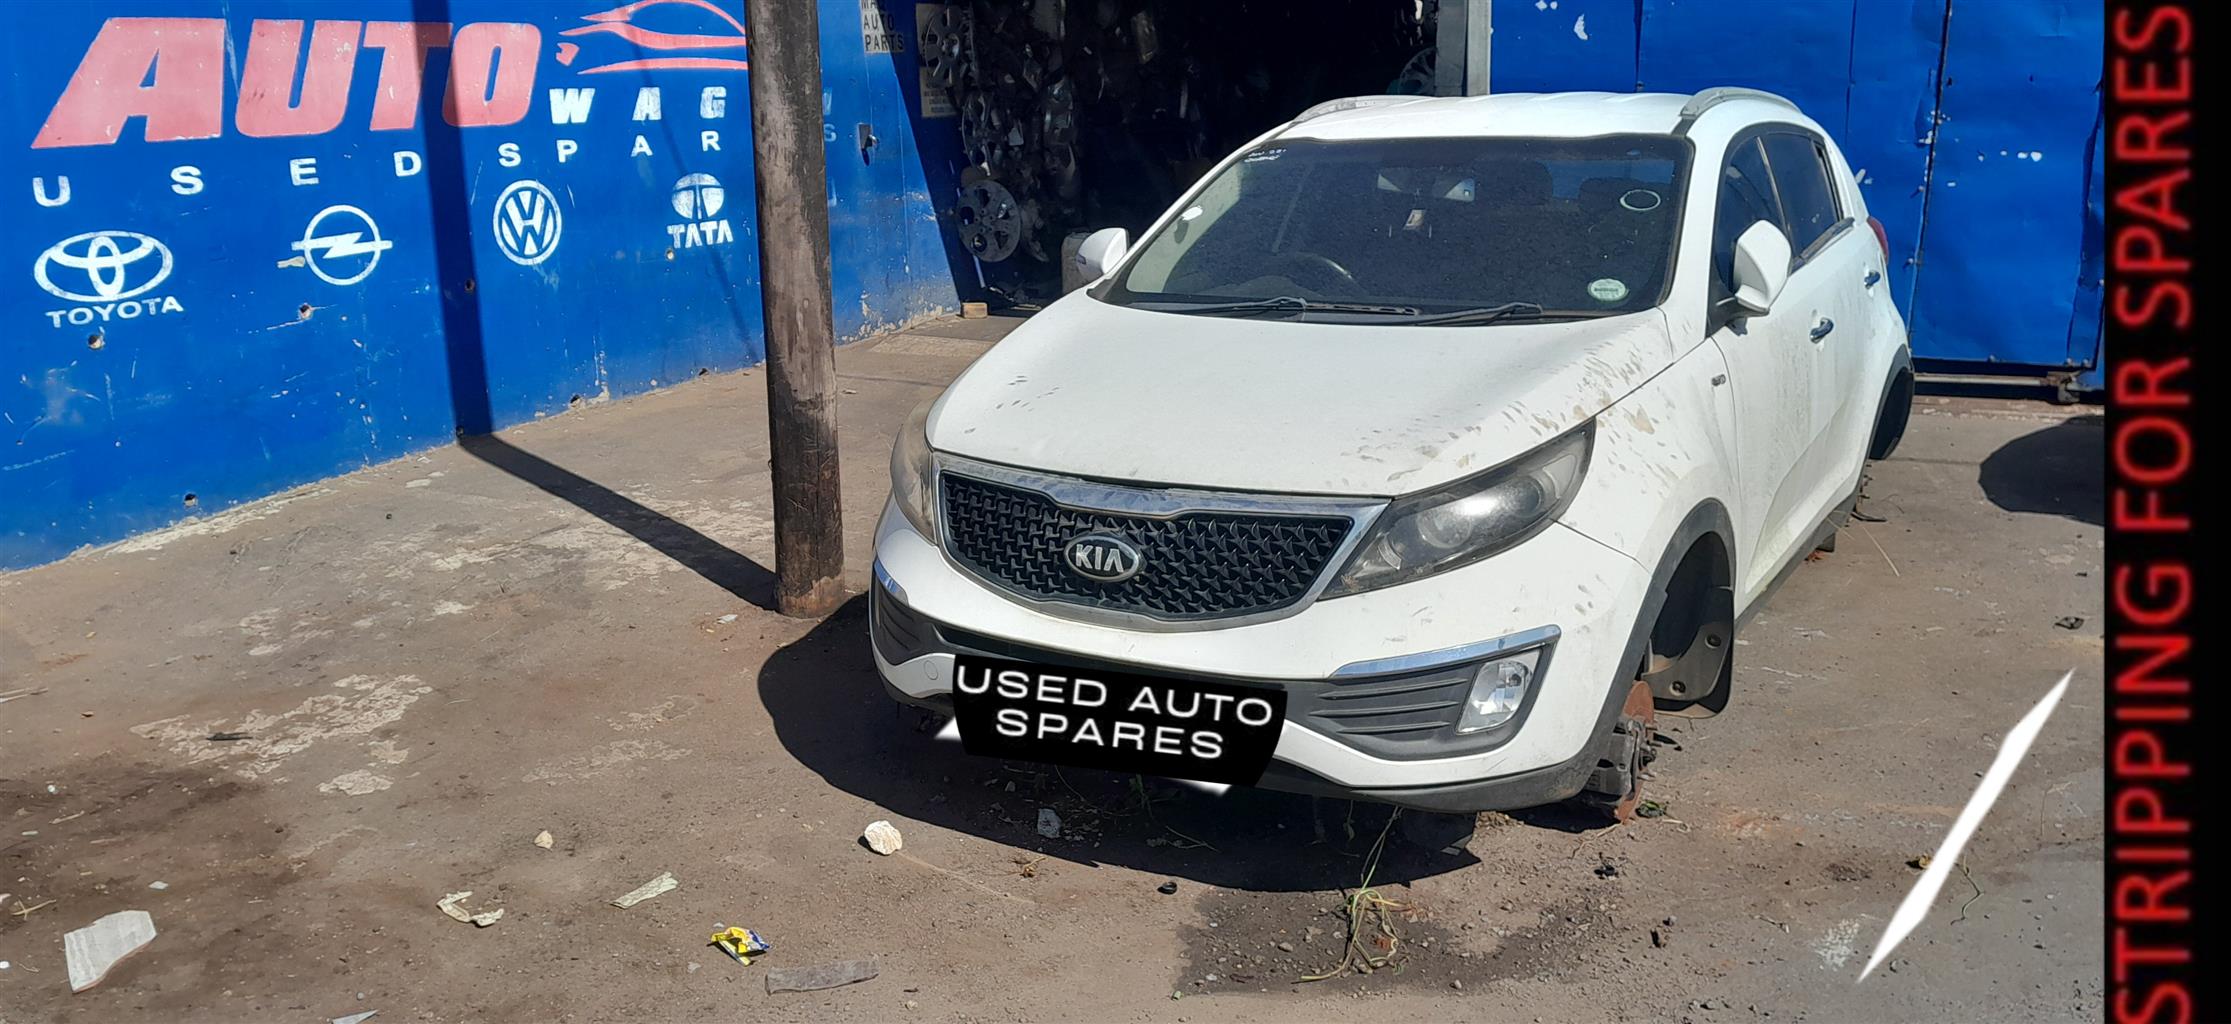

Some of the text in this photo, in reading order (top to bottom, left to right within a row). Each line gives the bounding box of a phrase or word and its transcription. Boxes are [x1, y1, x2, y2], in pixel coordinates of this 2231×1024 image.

[863, 14, 894, 31] AUTO
[865, 33, 904, 51] PARTS
[31, 17, 541, 149] AUTO
[32, 124, 837, 207] USED SPARS
[666, 219, 733, 249] TATA
[45, 295, 184, 328] TOYOTA
[1075, 543, 1126, 574] KIA
